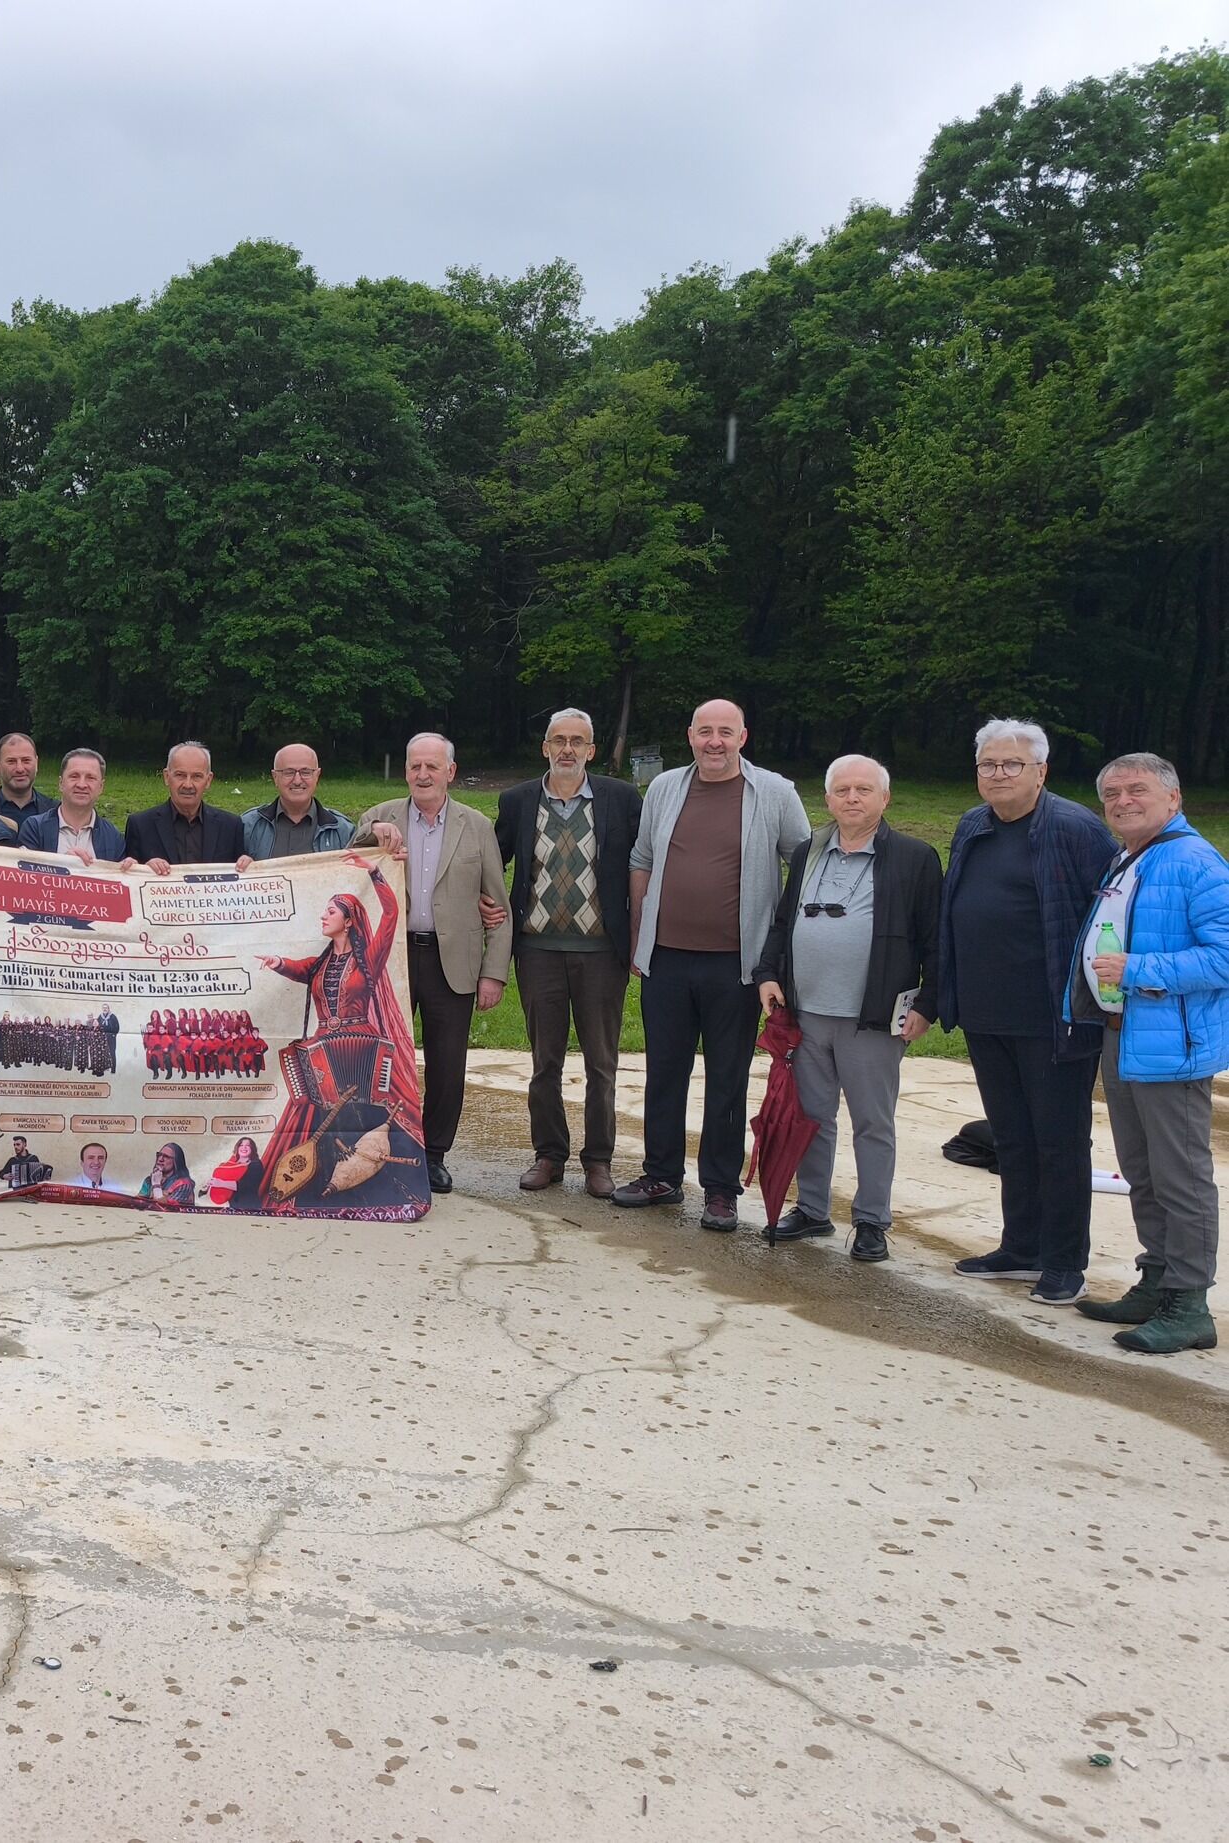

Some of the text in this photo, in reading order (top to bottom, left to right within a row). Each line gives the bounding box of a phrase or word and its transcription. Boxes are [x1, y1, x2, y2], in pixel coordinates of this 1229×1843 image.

[42, 877, 124, 895] CUMARTESİ
[150, 885, 195, 895] SAKARYA
[204, 880, 284, 894] KARAPÜRÇEK
[42, 889, 55, 899] VE
[150, 893, 285, 908] AHMETLER MAHALLESİ
[12, 897, 56, 912] MAYIS
[61, 905, 109, 918] PAZAR
[36, 914, 66, 925] 2 GÜN
[152, 908, 287, 923] GÜRCÜ ŞENLİĞİ ALANI
[59, 967, 124, 981] Cumartesi
[129, 971, 157, 981] Saat
[162, 972, 199, 982] 12:30
[204, 971, 220, 981] da
[38, 978, 124, 993] Müsabakaları
[128, 982, 145, 993] ile
[149, 983, 242, 997] başlayacaktır.
